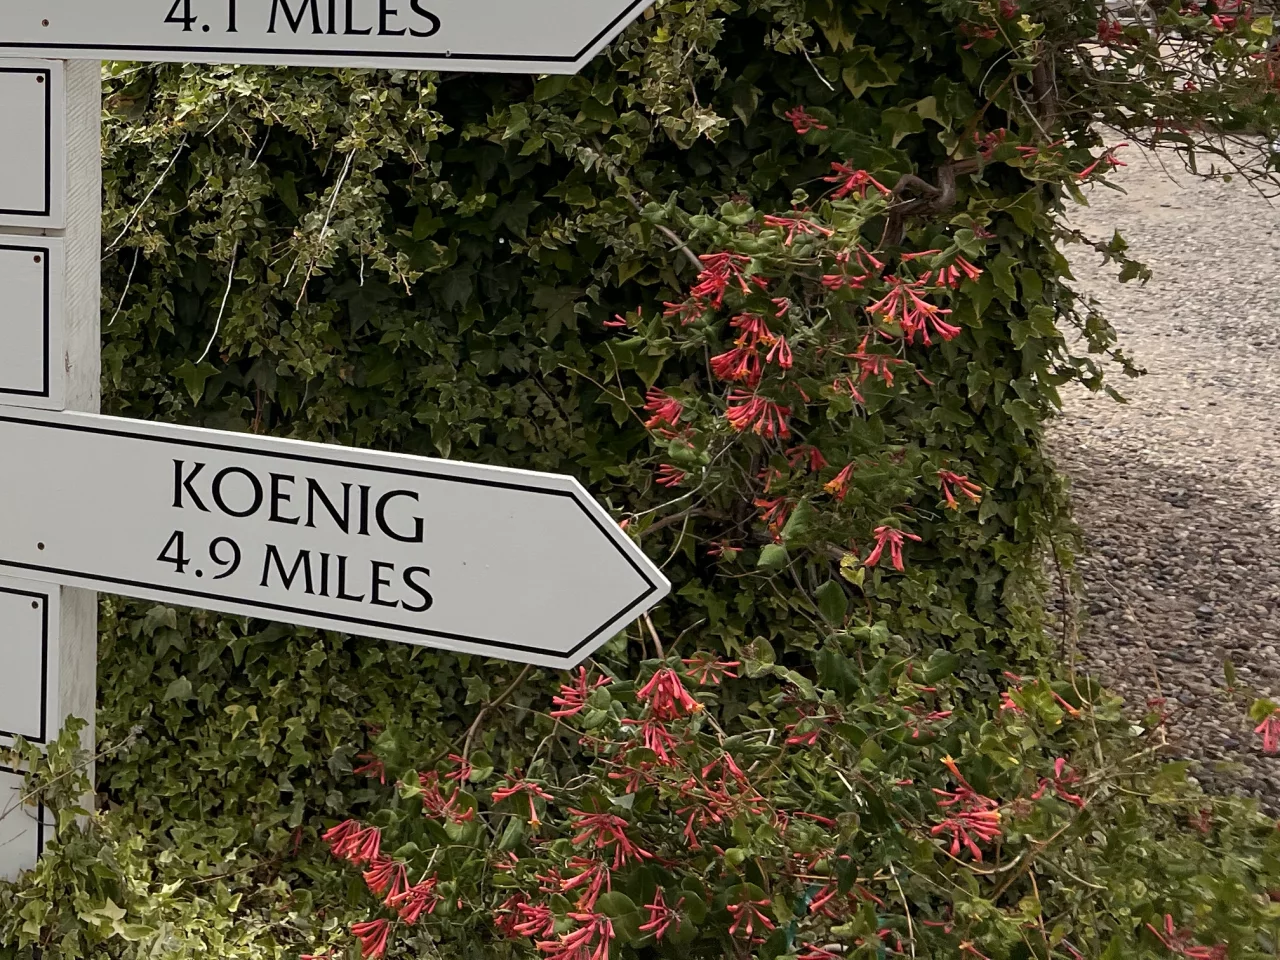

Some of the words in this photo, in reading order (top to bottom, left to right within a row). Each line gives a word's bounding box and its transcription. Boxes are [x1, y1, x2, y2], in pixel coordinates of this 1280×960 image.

[171, 458, 425, 544] KOENIG
[155, 529, 242, 580] 4.9
[258, 543, 434, 613] MILES
